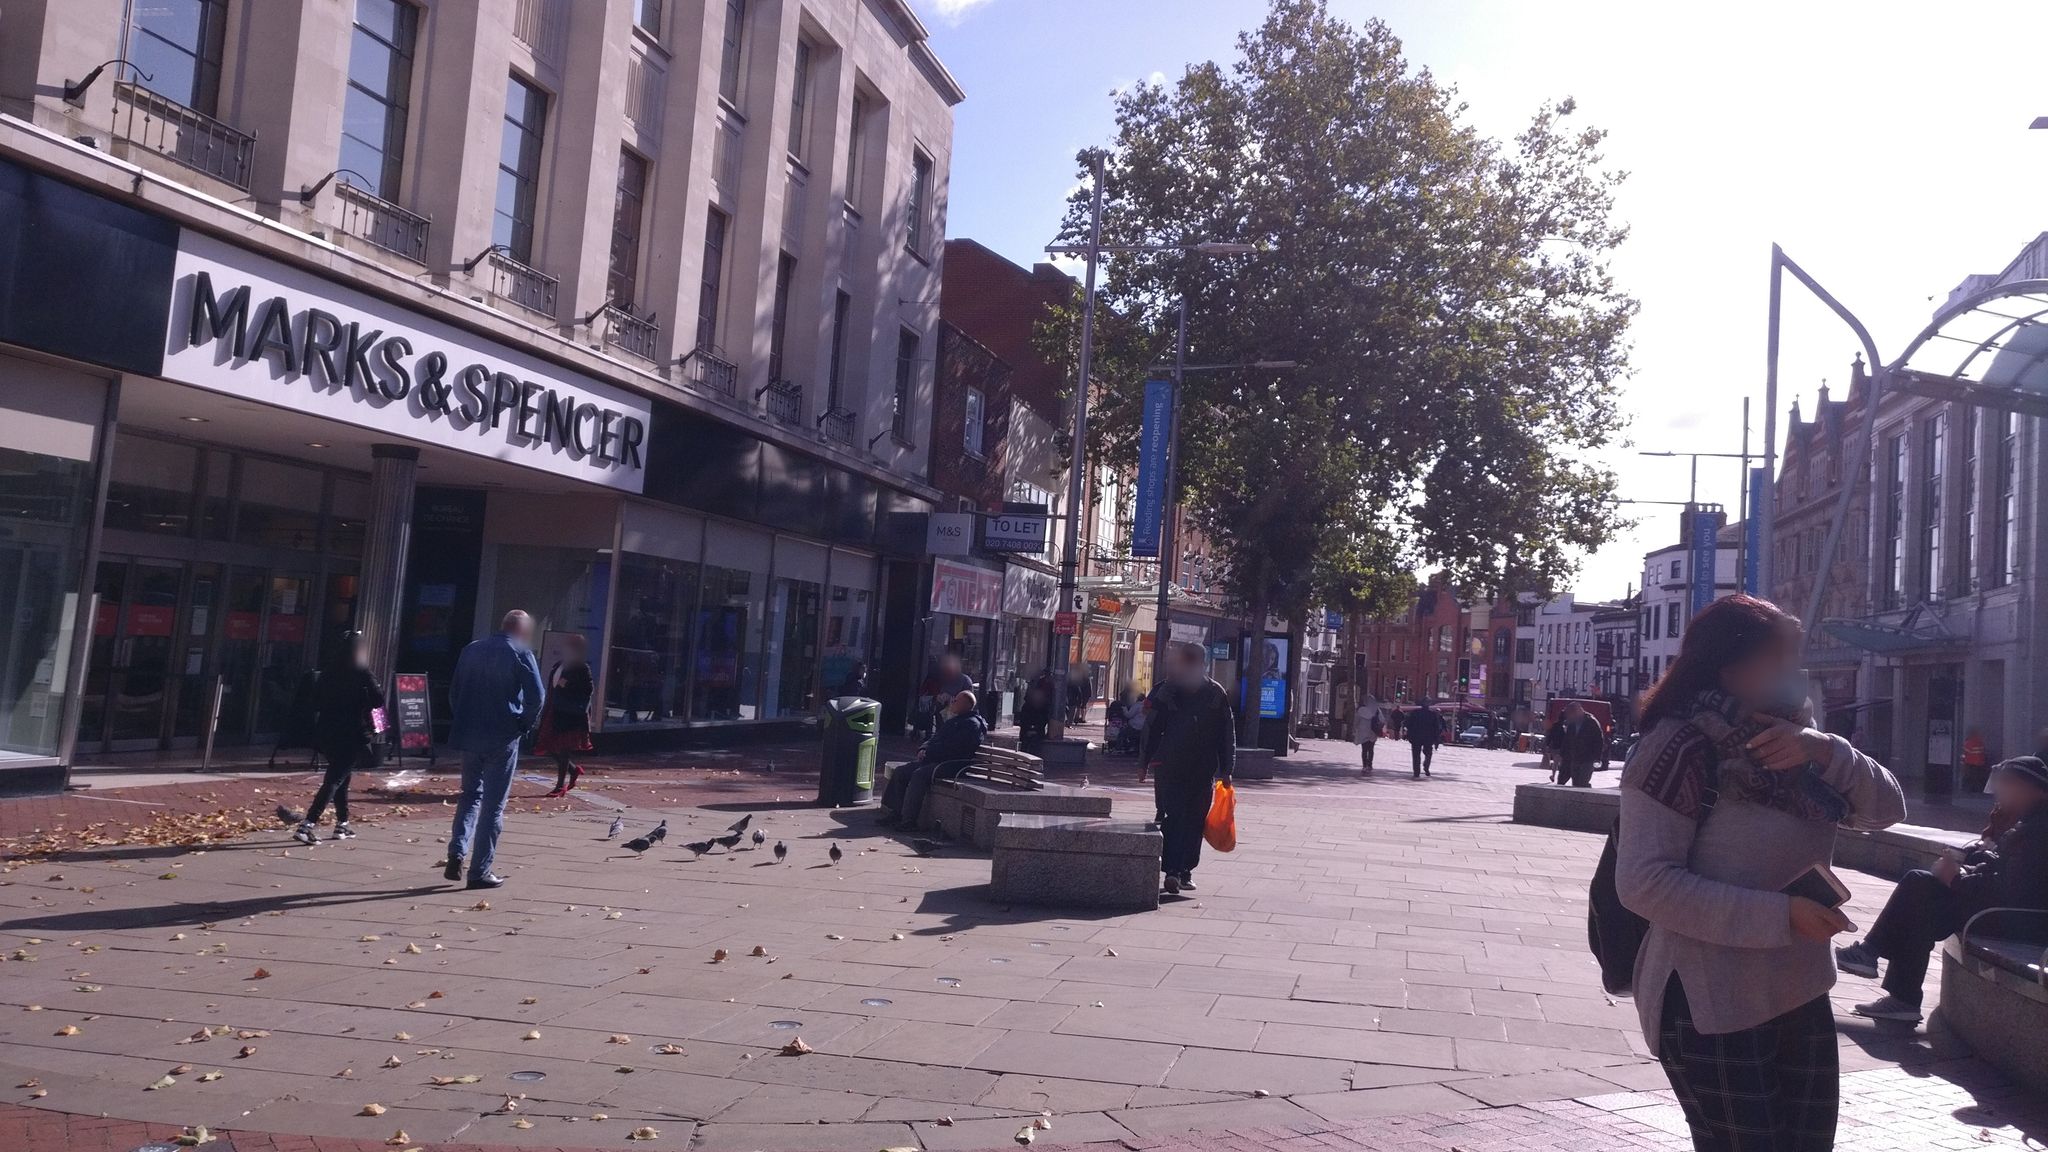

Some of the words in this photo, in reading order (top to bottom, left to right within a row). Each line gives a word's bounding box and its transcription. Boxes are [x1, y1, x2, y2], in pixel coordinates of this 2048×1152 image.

[189, 270, 414, 401] MARKS
[460, 362, 644, 469] SPENCER
[1150, 402, 1163, 452] reopening
[1149, 455, 1158, 469] are
[1145, 471, 1157, 497] shops
[1142, 498, 1156, 535] Reading
[936, 525, 961, 537] M&S
[992, 520, 1010, 532] TO
[1014, 521, 1040, 534] LET
[985, 539, 1000, 547] 020
[1703, 528, 1712, 547] you
[1702, 550, 1710, 568] see
[1701, 571, 1710, 581] to
